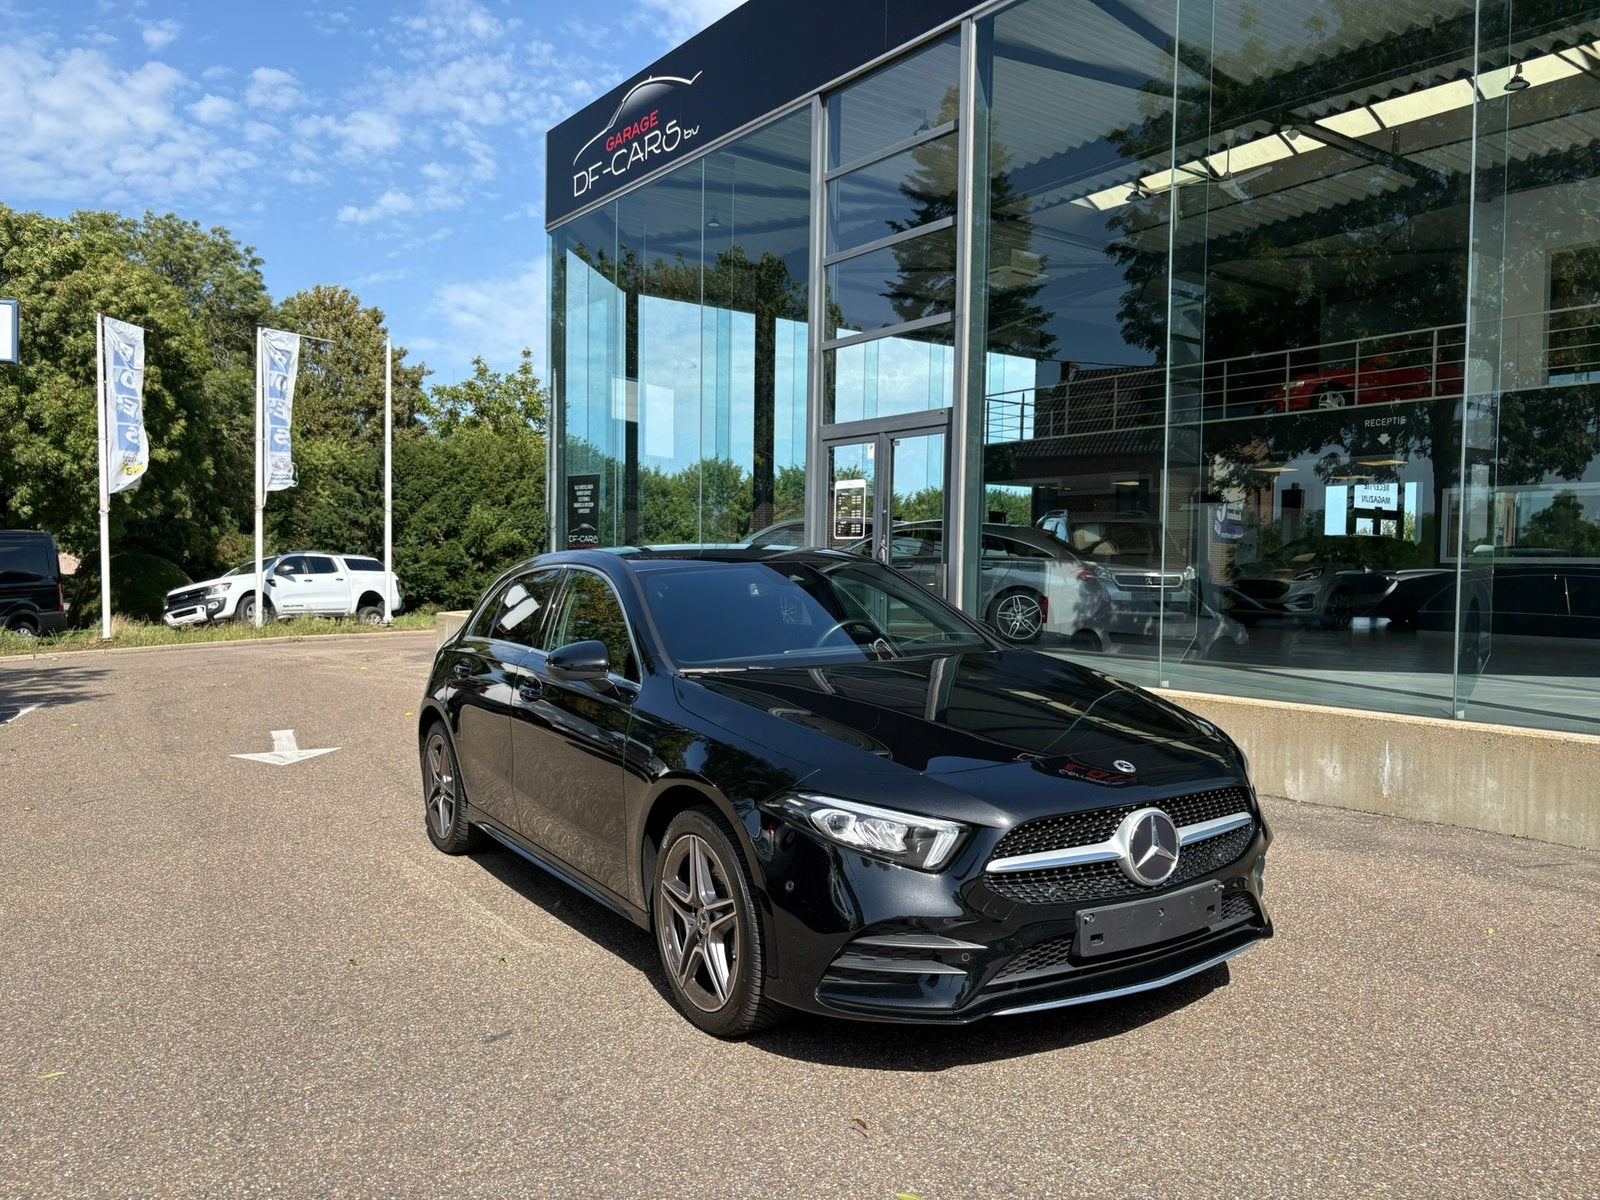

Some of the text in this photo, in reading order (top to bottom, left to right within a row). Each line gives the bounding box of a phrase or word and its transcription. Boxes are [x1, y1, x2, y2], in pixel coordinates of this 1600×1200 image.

[605, 110, 660, 152] GARAGE
[573, 120, 682, 198] DF-CARS
[1364, 416, 1407, 428] RECEPTIE
